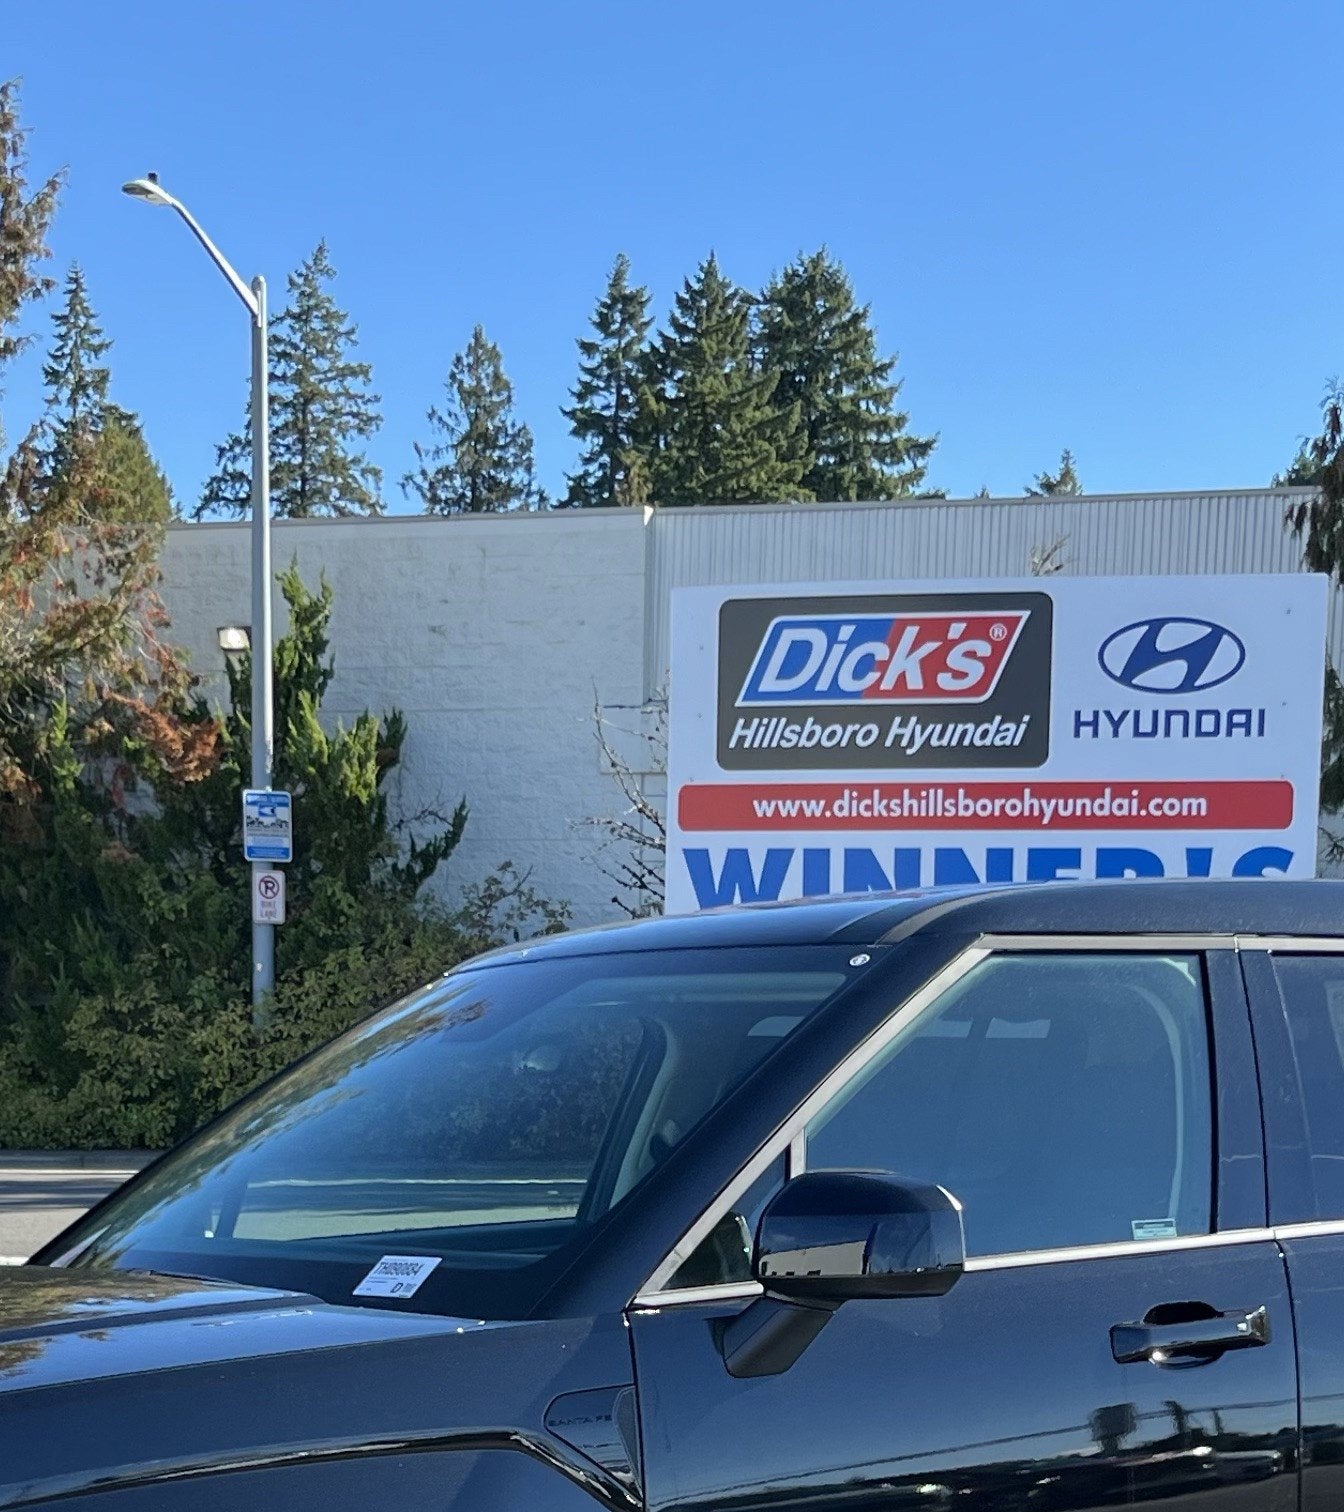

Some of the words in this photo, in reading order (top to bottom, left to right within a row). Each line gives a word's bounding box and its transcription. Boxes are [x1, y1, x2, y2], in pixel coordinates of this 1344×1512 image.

[729, 716, 880, 750] Hillsboro
[883, 714, 1031, 756] Hyundai
[1073, 708, 1265, 740] HYUNDAI
[752, 788, 1209, 827] www.dickshillsborohyundai.com
